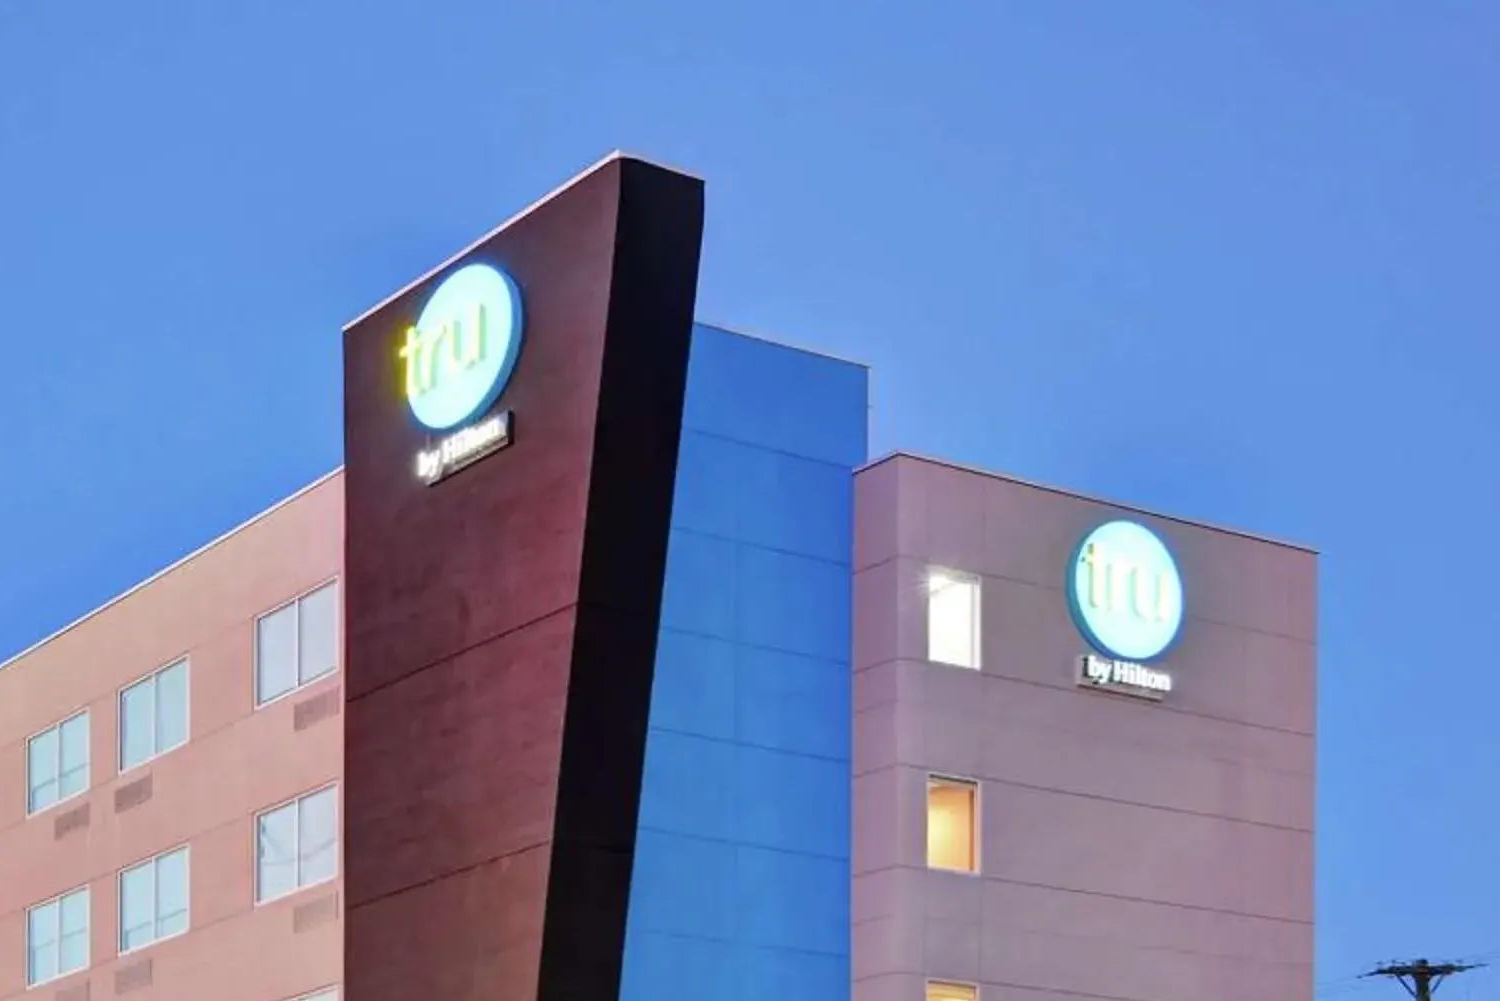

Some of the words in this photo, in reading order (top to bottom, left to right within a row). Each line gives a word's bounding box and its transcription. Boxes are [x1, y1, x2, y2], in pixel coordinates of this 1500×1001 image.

[399, 302, 487, 396] tru
[417, 449, 440, 479] by
[442, 415, 504, 463] Hin
[1080, 543, 1169, 622] tru
[1085, 654, 1113, 684] by
[1113, 659, 1171, 691] Hilton
